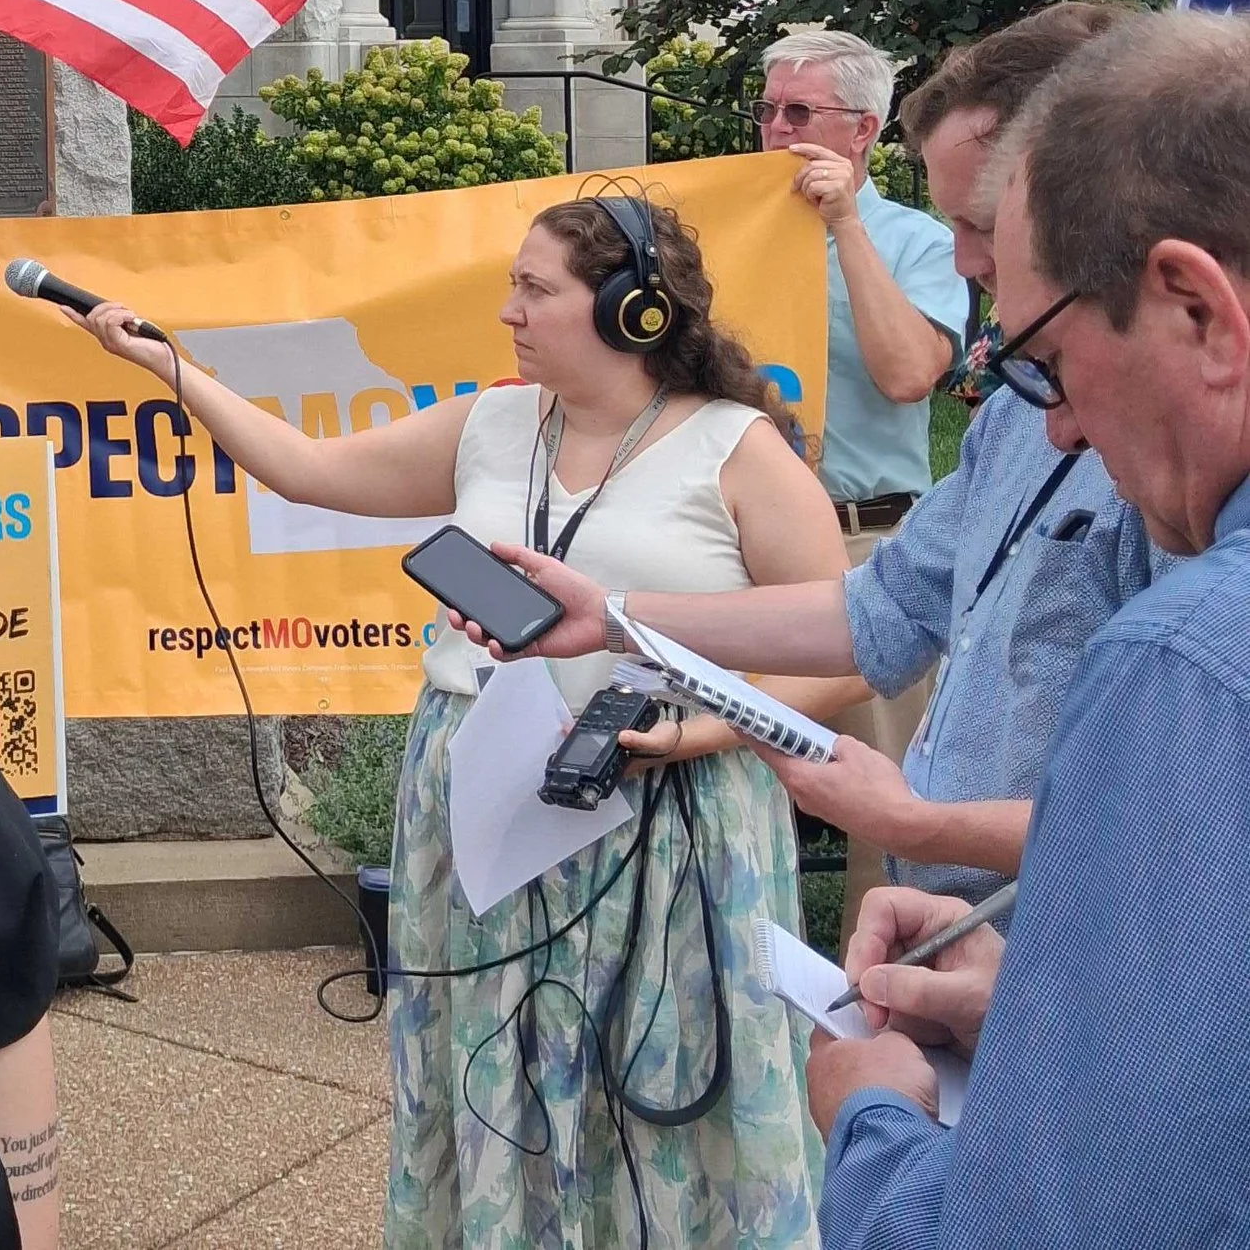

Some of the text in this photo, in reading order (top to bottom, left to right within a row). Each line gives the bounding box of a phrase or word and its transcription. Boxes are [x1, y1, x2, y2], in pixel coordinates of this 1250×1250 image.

[0, 1136, 27, 1154] You
[28, 1129, 47, 1154] just
[5, 1152, 46, 1178] ourself
